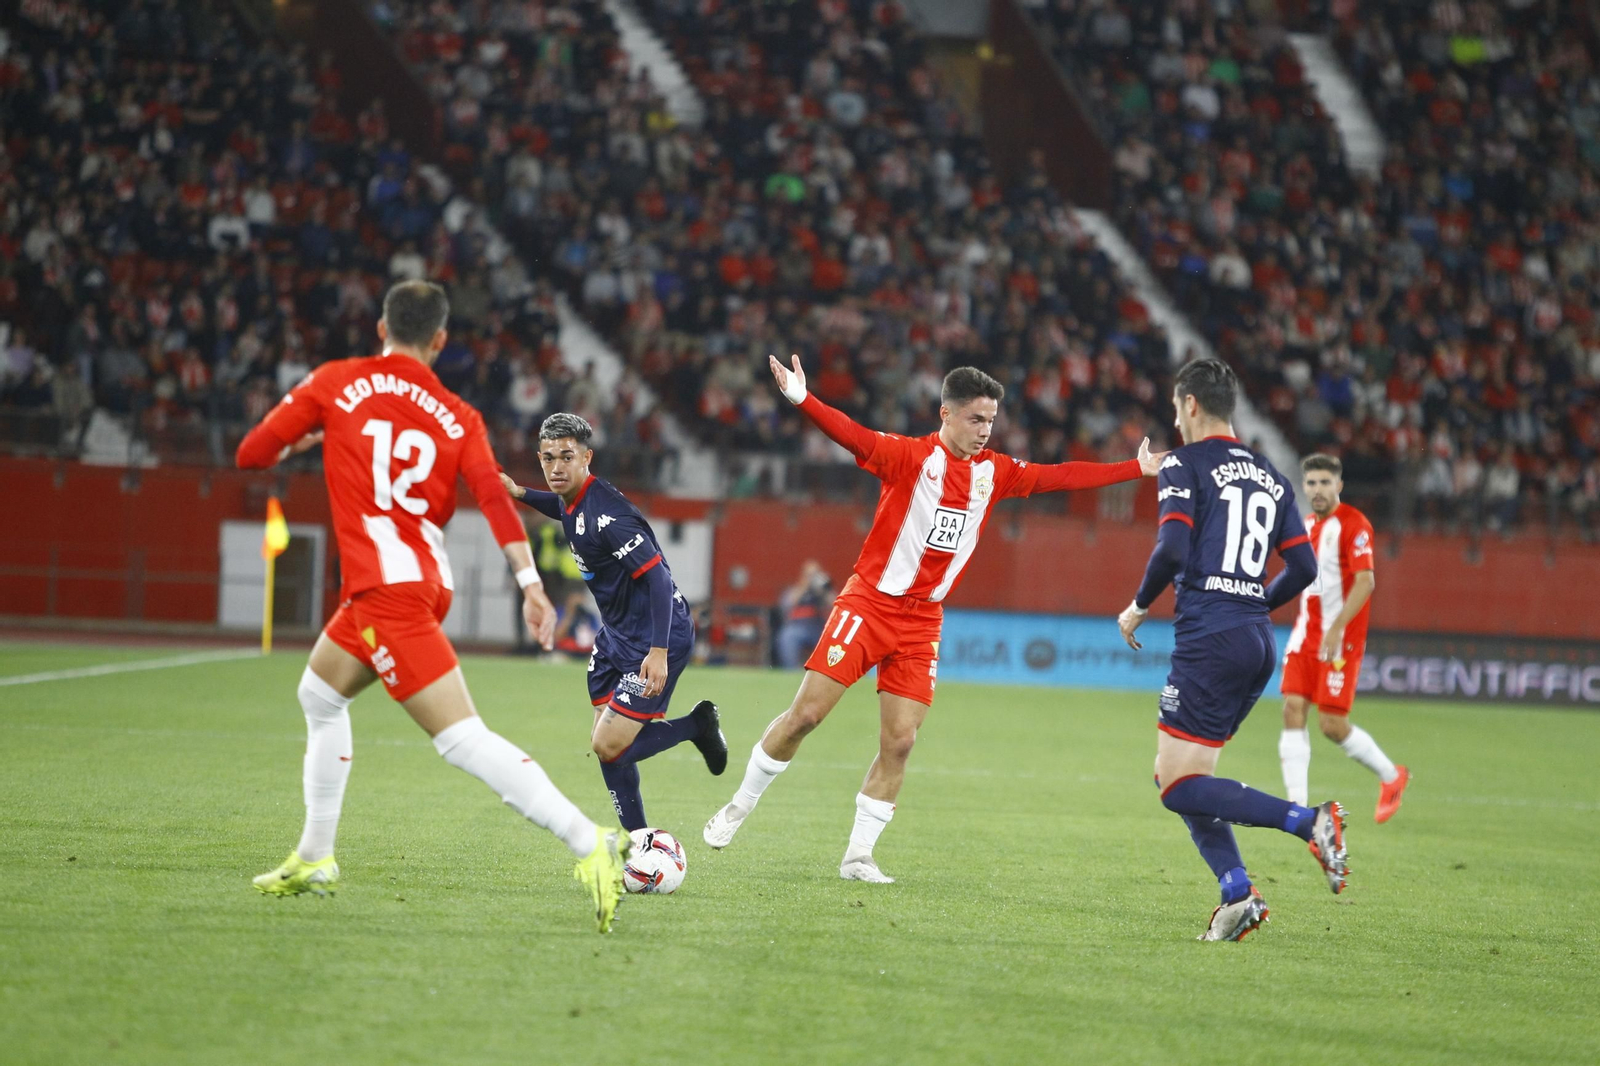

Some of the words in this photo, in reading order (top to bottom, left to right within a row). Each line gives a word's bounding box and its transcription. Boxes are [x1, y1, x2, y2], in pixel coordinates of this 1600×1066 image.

[335, 378, 373, 413] LEO
[370, 373, 465, 440] BAPTISTAO
[361, 419, 437, 515] 12
[1211, 461, 1285, 502] ESCUDERO
[611, 533, 645, 560] DIGI
[1219, 485, 1277, 577] 18
[832, 610, 863, 645] 11
